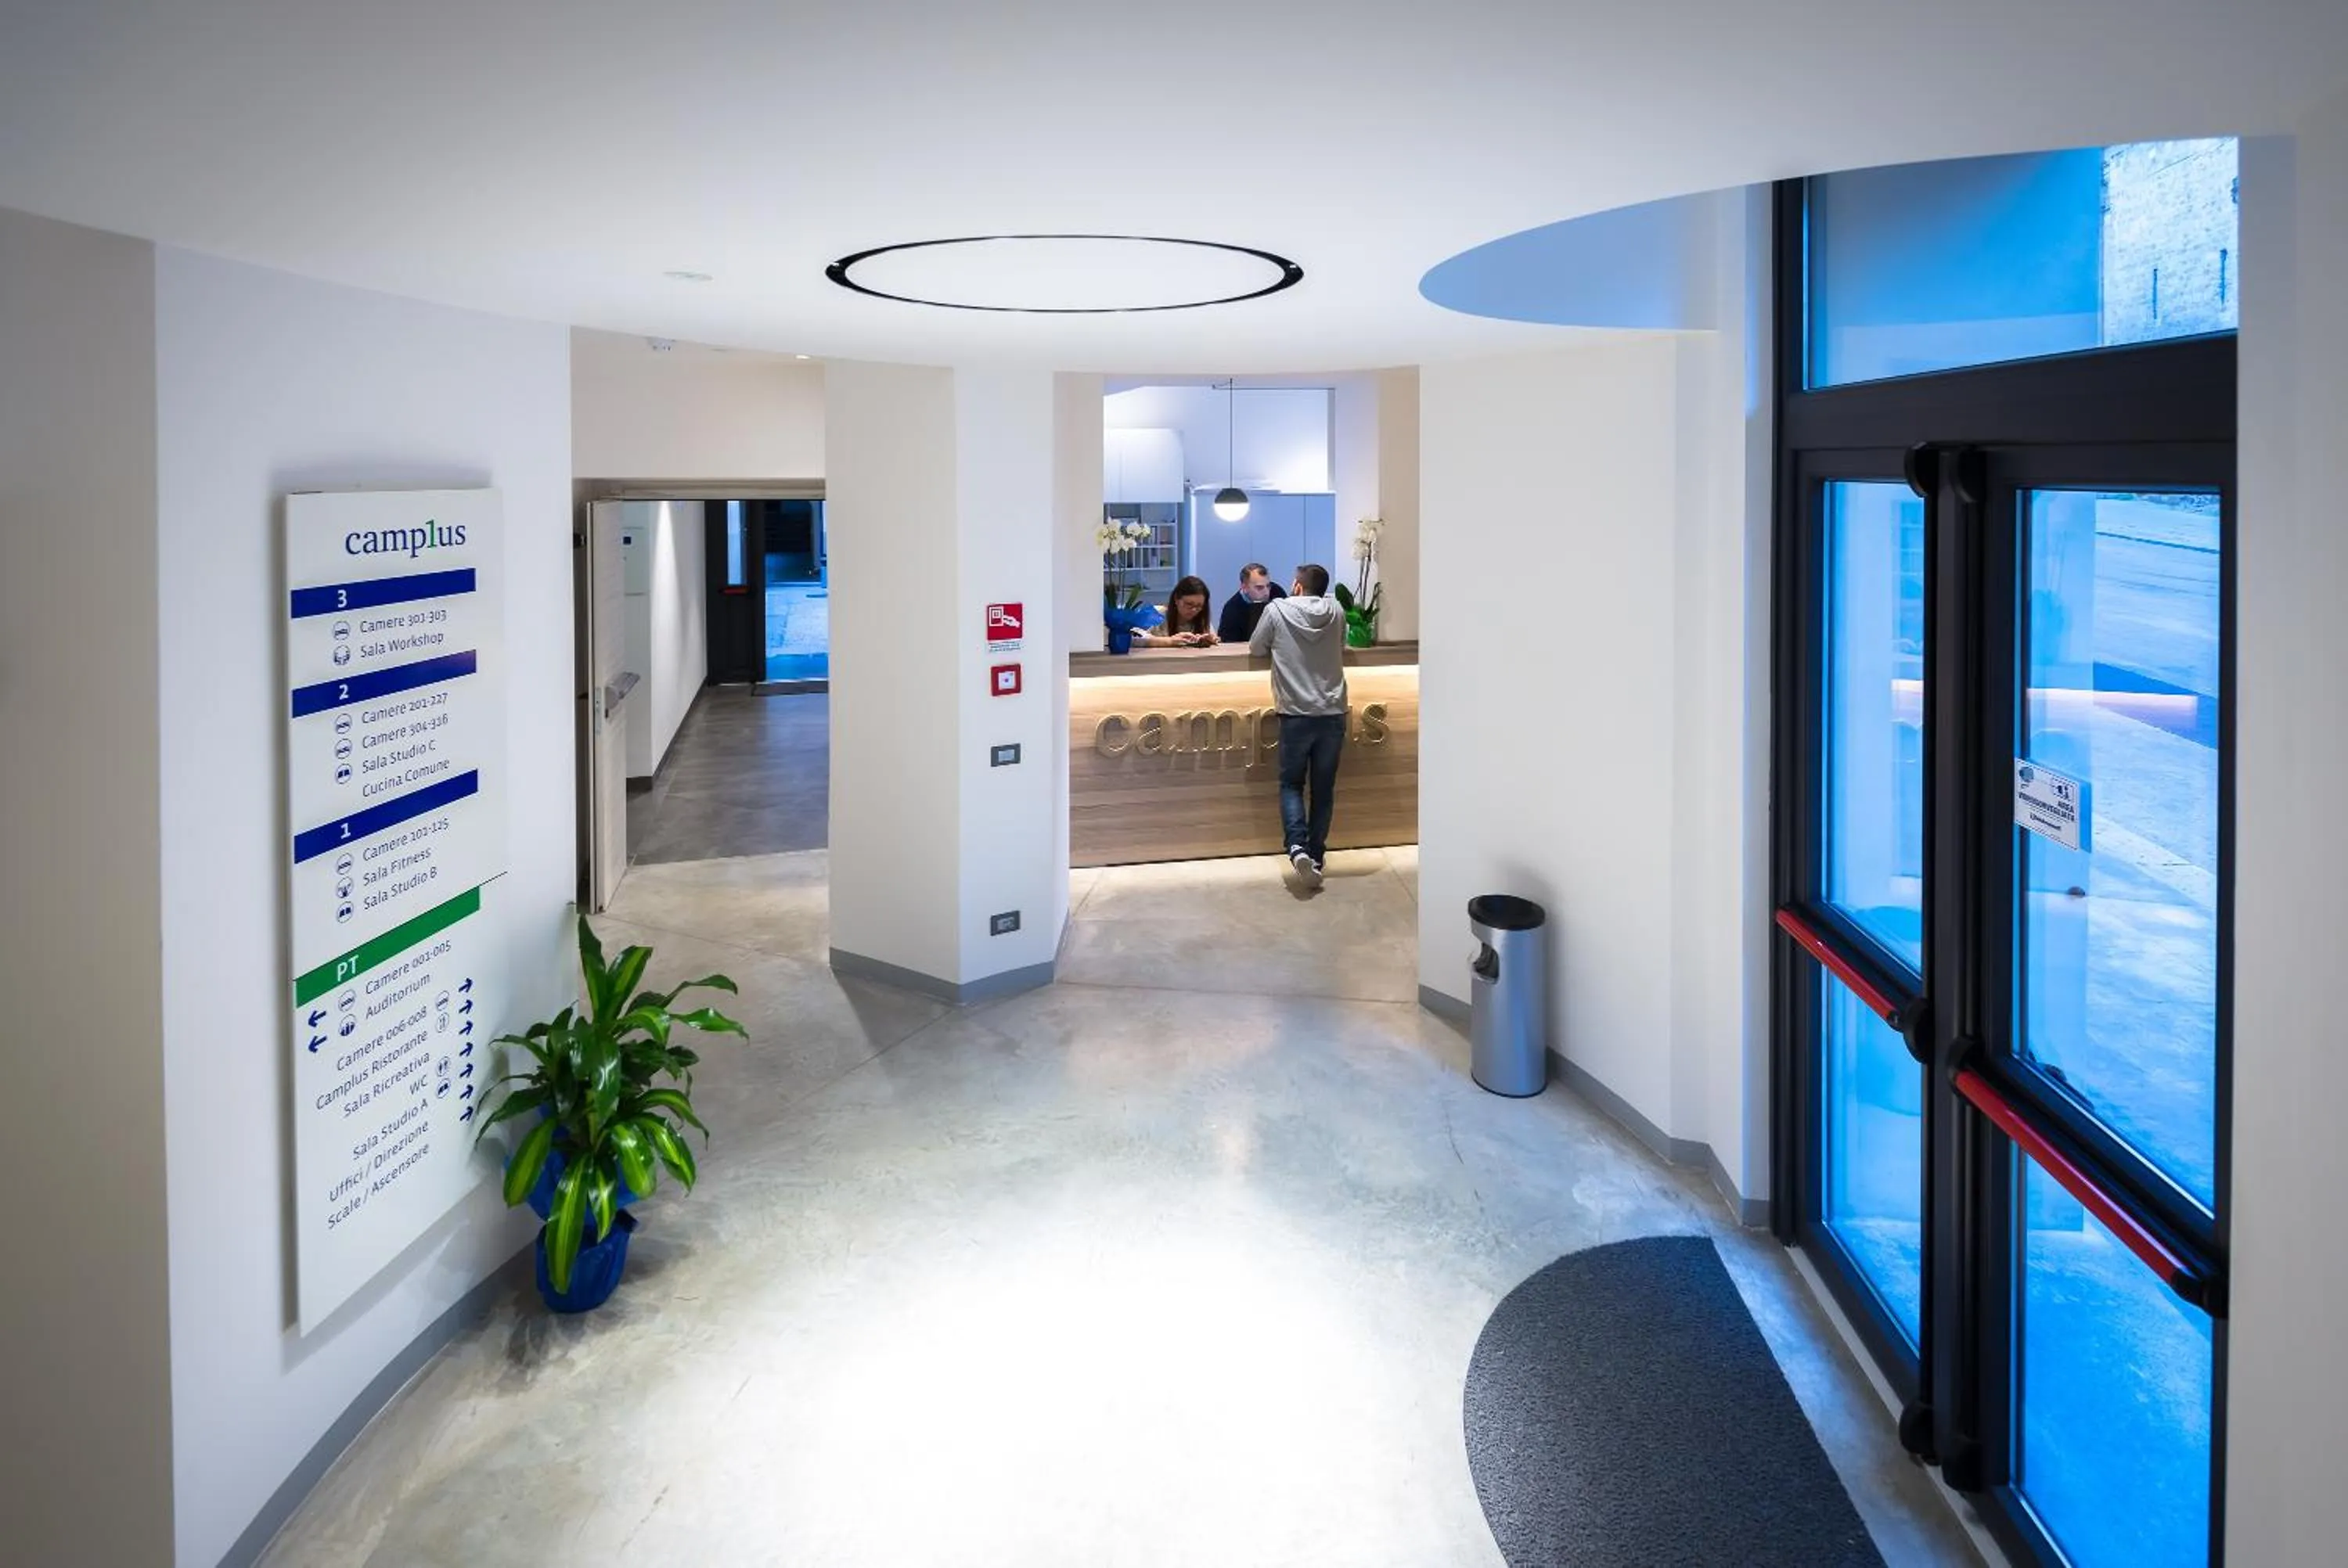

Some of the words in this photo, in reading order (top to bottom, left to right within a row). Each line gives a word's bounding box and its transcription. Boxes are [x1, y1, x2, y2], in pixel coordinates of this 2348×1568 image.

[345, 519, 466, 558] camplus
[337, 589, 347, 608] 3
[359, 617, 405, 633] Camere
[408, 610, 447, 627] 301-303
[360, 642, 386, 658] Sala
[388, 632, 445, 652] Workshop
[339, 684, 349, 700] 2
[362, 704, 406, 724] Camere
[409, 692, 448, 711] 201-227
[362, 727, 406, 749] Camere
[1096, 702, 1392, 768] camps
[362, 755, 387, 774] Sala
[391, 743, 427, 764] Studio
[428, 739, 436, 751] C
[362, 775, 403, 797] Cucina
[405, 759, 450, 782] Comune
[340, 822, 351, 840] 1
[362, 835, 408, 861] Camere
[411, 818, 449, 842] 101-125
[362, 866, 388, 886] Sala
[391, 847, 432, 874] Fitness
[363, 890, 388, 910] Sala
[391, 872, 428, 897] Studio
[430, 866, 438, 879] B
[337, 955, 359, 982] PT
[366, 963, 409, 994] Camere
[412, 940, 452, 969] 001-005
[366, 973, 430, 1020] Auditorium
[337, 1035, 384, 1071] Camere
[386, 1005, 427, 1039] 006-008
[315, 1070, 369, 1110] Camplus
[372, 1030, 428, 1074] Ristorante
[344, 1094, 370, 1118] Sala
[373, 1052, 430, 1097] Ricreativa
[409, 1074, 428, 1095] WC
[353, 1135, 378, 1160] Sala
[381, 1106, 419, 1139] Studio
[420, 1098, 428, 1110] A
[330, 1167, 363, 1203] Uffici
[374, 1120, 429, 1169] Direzione
[327, 1196, 362, 1229] Scale
[370, 1143, 429, 1196] Ascensore
